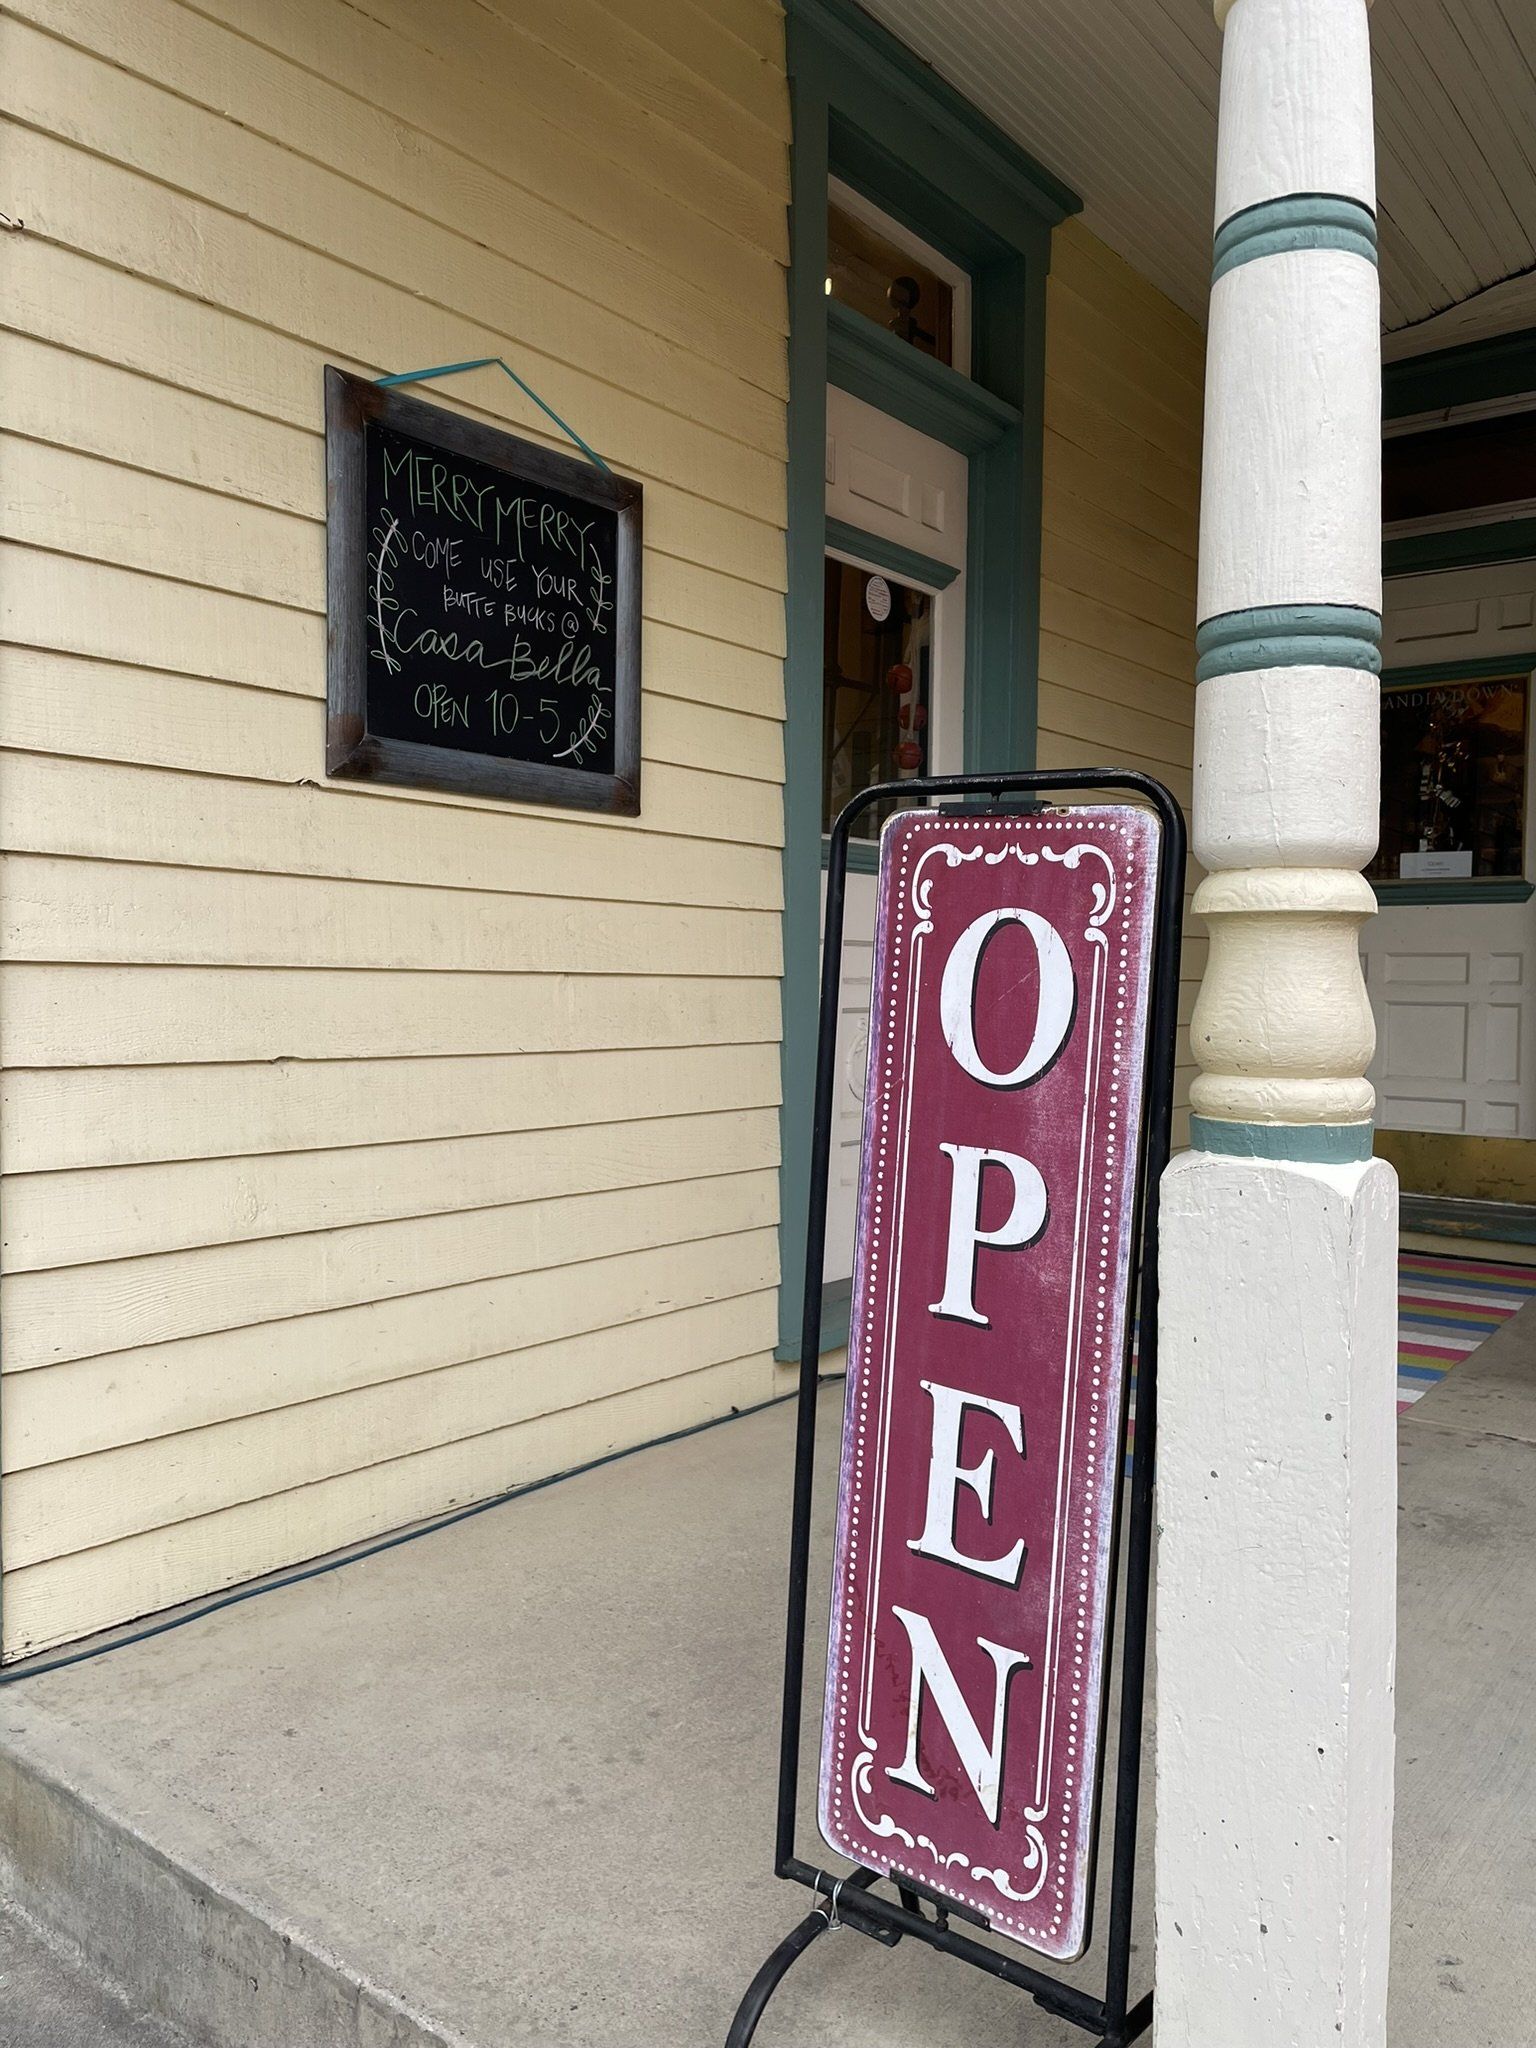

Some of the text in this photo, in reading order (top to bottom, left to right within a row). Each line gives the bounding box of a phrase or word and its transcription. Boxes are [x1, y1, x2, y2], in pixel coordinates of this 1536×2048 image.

[383, 447, 595, 571] MERRY MERRY
[412, 530, 584, 606] COME USE YOUR
[393, 608, 612, 692] Casa Bella
[443, 584, 579, 638] BUTTE BUCKS @
[414, 683, 560, 743] OPEN 10-5
[885, 906, 1078, 1830] OPEN
